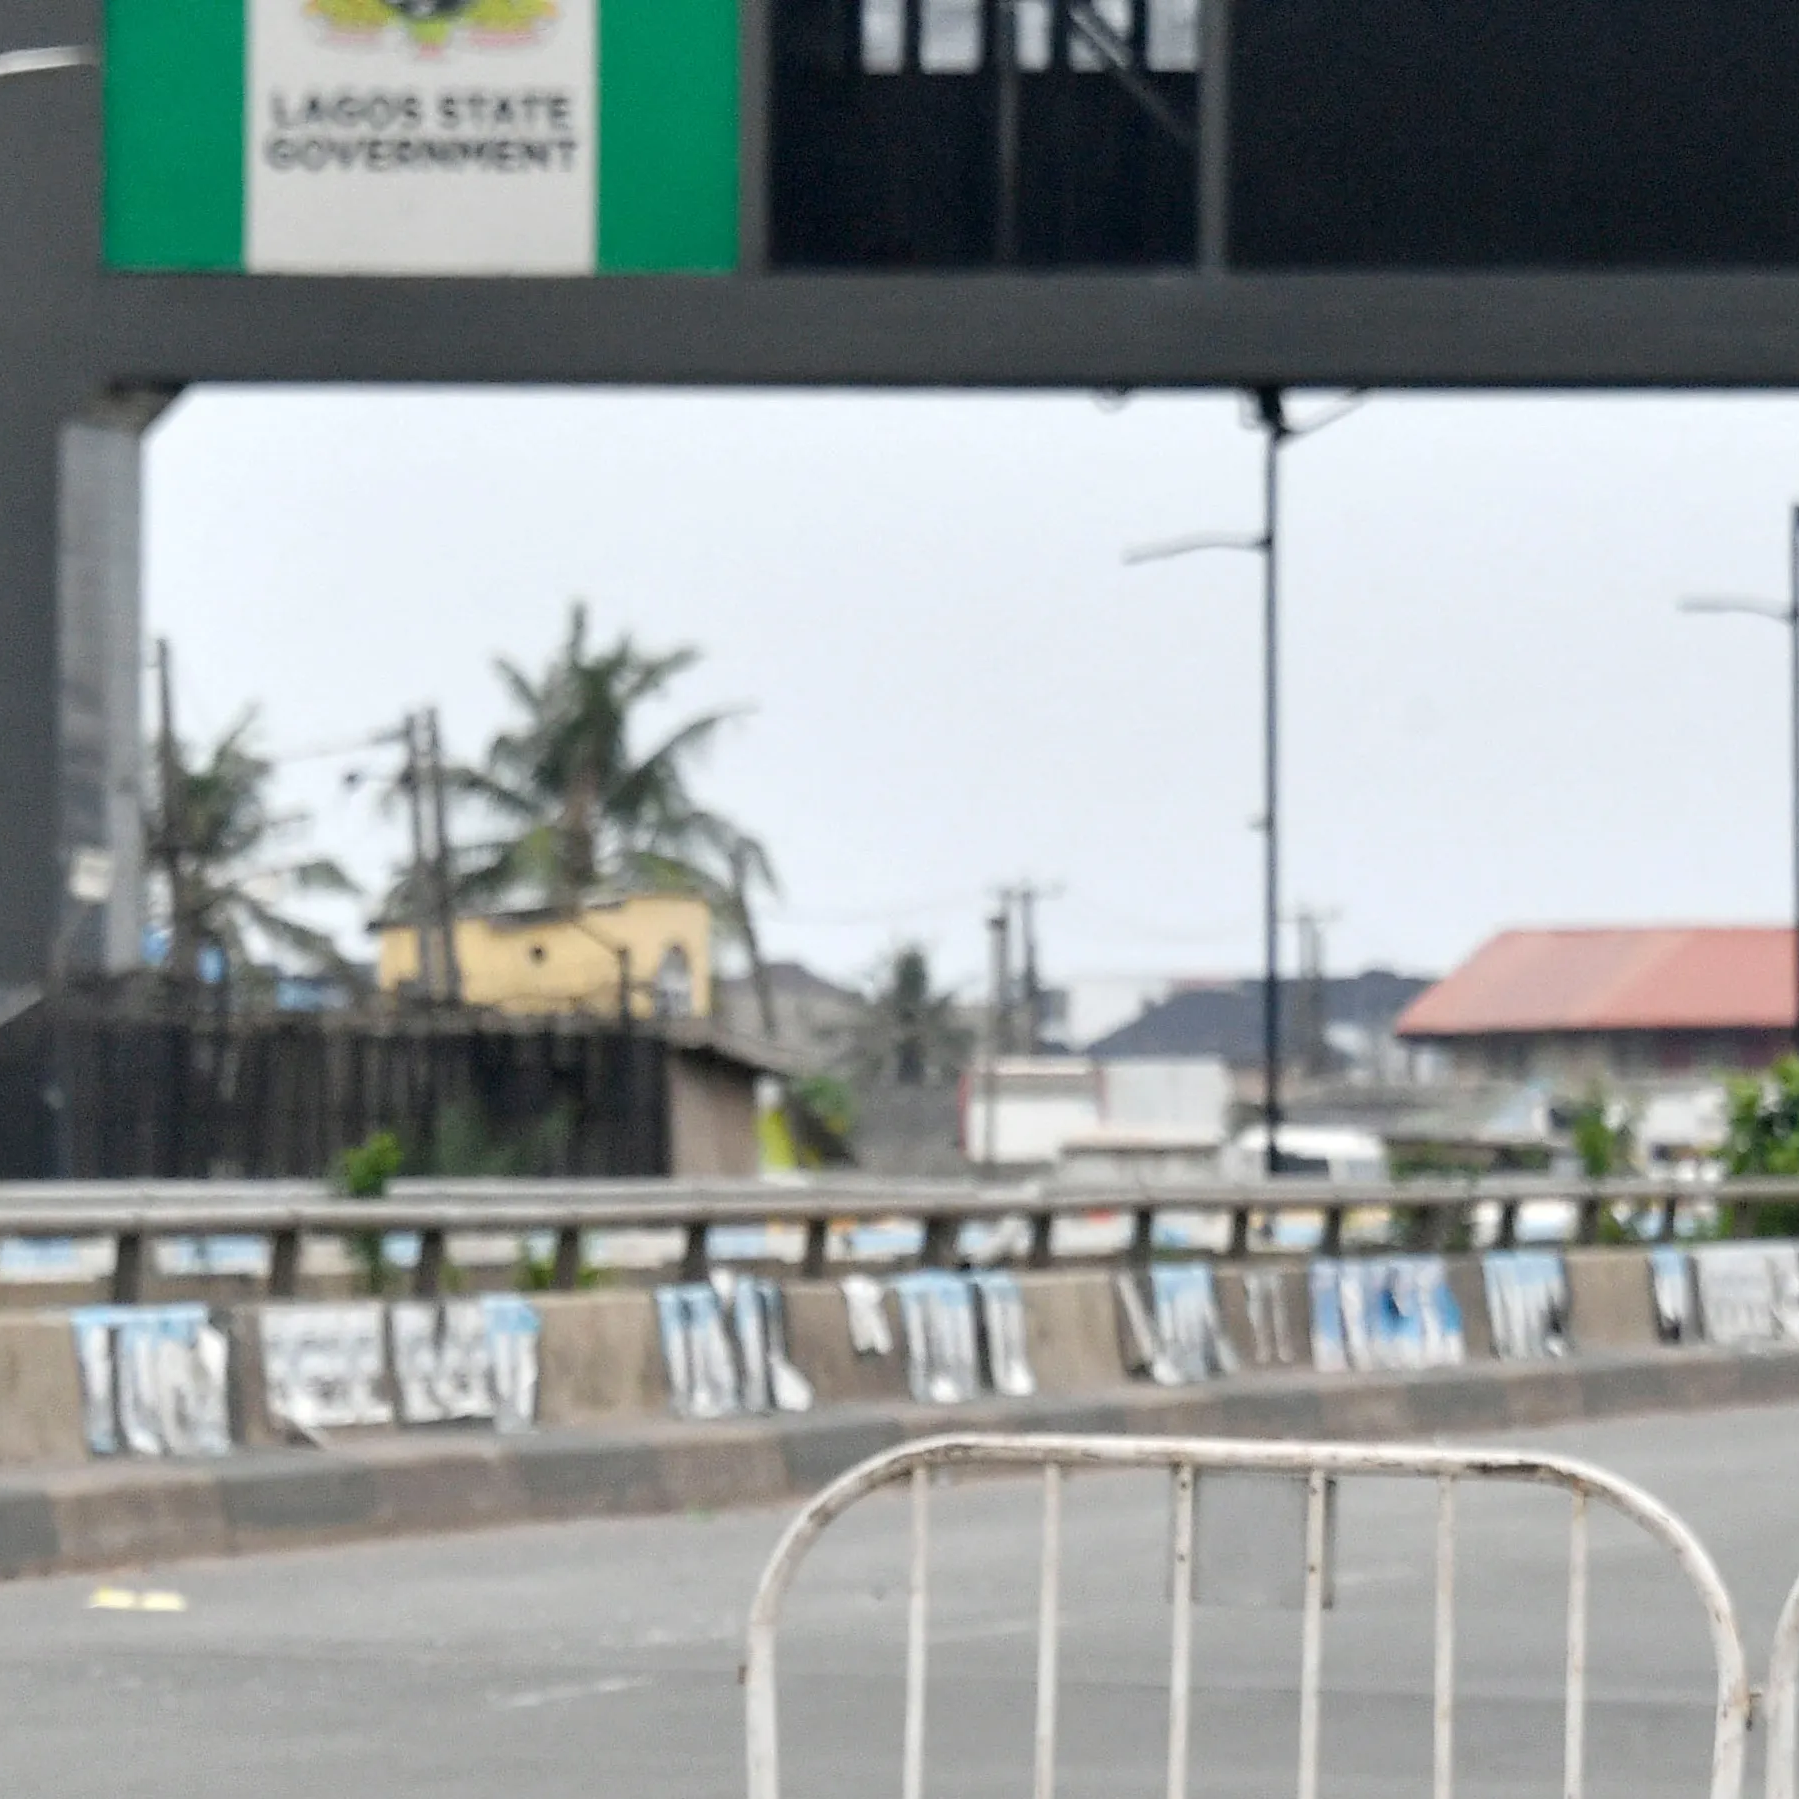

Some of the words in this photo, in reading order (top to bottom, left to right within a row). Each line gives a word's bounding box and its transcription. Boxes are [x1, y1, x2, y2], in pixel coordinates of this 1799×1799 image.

[269, 95, 422, 129] LAGOS
[439, 95, 572, 129] STATE
[265, 138, 577, 172] GOVERNMENT
